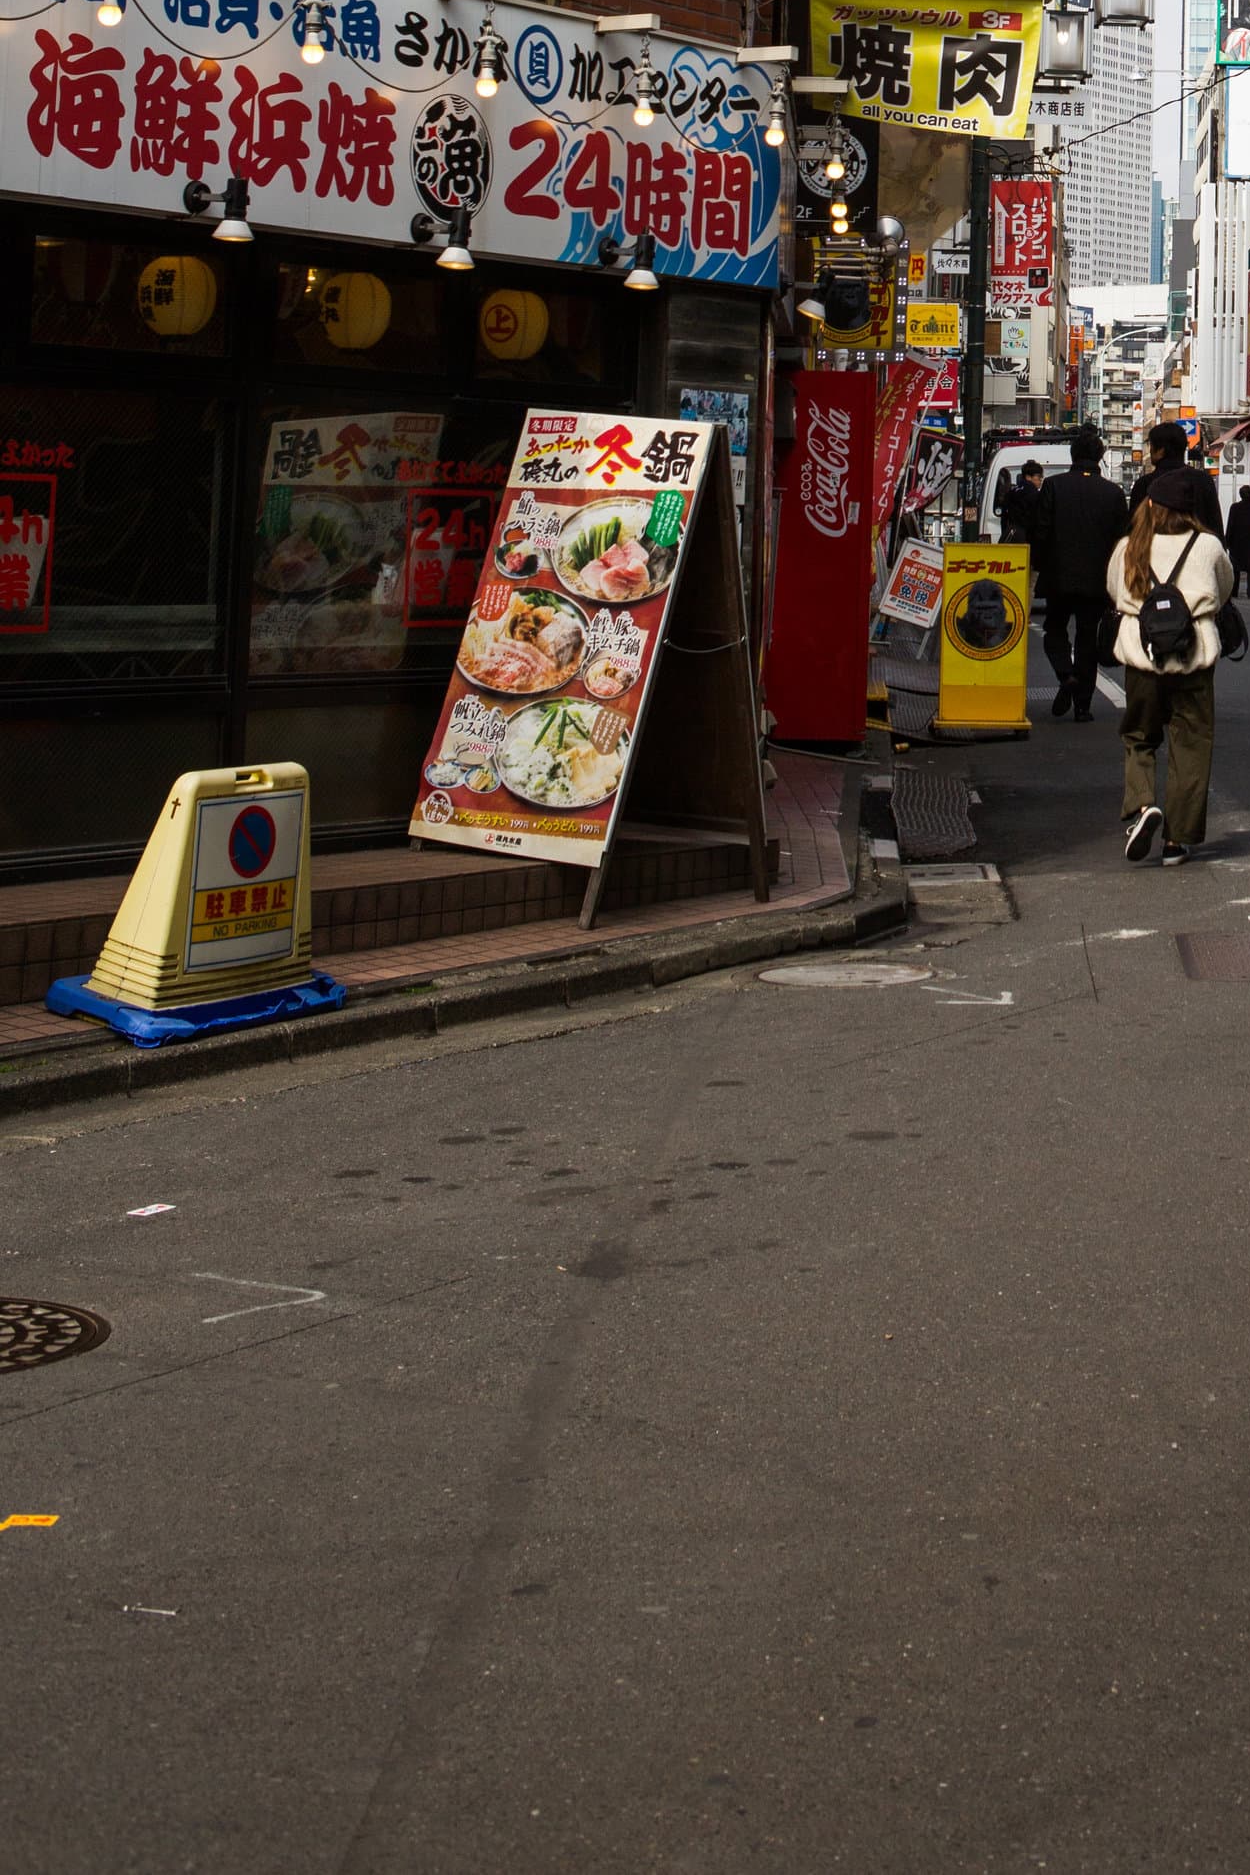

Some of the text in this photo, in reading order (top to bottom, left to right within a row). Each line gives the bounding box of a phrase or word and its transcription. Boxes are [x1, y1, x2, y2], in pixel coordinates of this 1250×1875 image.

[831, 5, 1010, 29] ガッツソウル 3F
[830, 23, 1025, 117] 焼肉
[27, 28, 397, 206] 海鮮浜焼
[862, 103, 979, 132] all you can eat
[796, 204, 813, 218] 2F
[1012, 203, 1028, 266] スロット
[1031, 195, 1049, 260] パチンコ
[992, 280, 1026, 293] 代々木
[992, 293, 1034, 305] アクアス
[529, 418, 577, 433] 冬期限定
[520, 456, 580, 485] 磯丸の
[204, 882, 289, 921] 駐車禁止
[213, 916, 278, 938] NO PARKING
